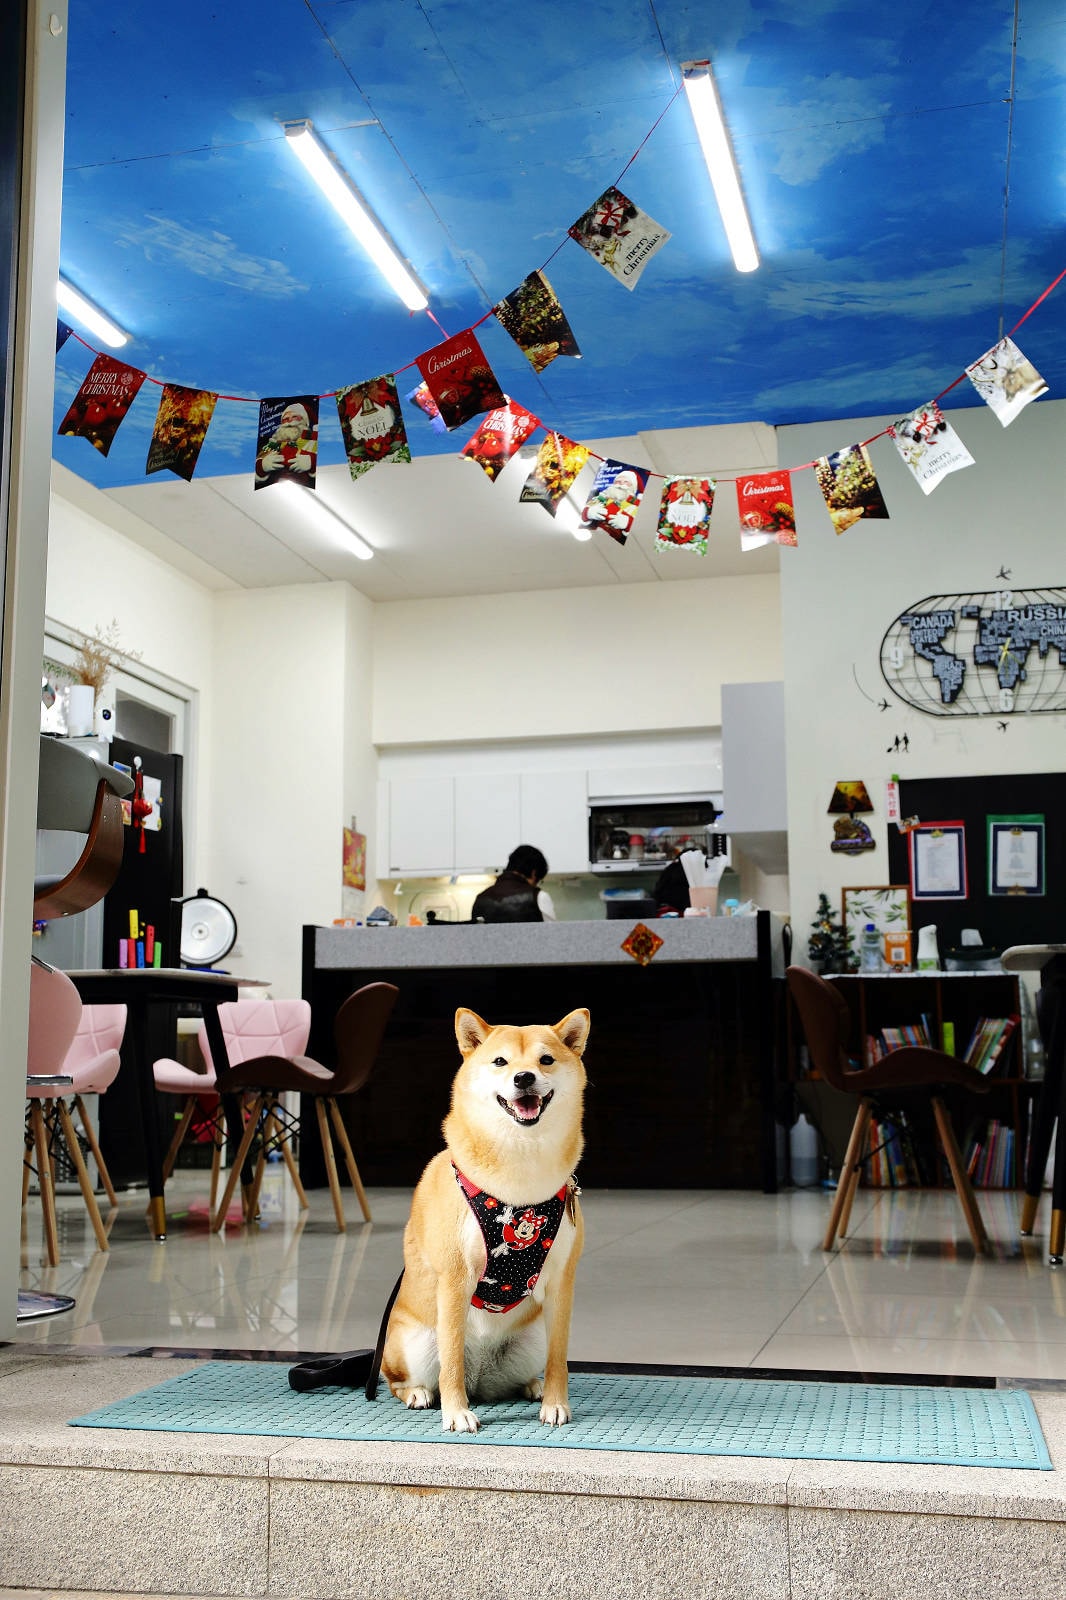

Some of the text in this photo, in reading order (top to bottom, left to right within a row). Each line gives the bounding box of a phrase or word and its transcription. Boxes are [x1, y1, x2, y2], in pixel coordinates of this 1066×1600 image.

[624, 234, 660, 275] Christmas
[626, 238, 648, 261] merry
[428, 347, 473, 374] Christmas
[90, 371, 118, 383] MERRY
[82, 384, 129, 396] CHRISTMAS
[928, 452, 951, 469] merry
[743, 480, 785, 496] Christmas
[992, 590, 1014, 610] 12
[912, 615, 955, 628] CANADA
[890, 646, 904, 670] 9
[999, 688, 1015, 712] 6
